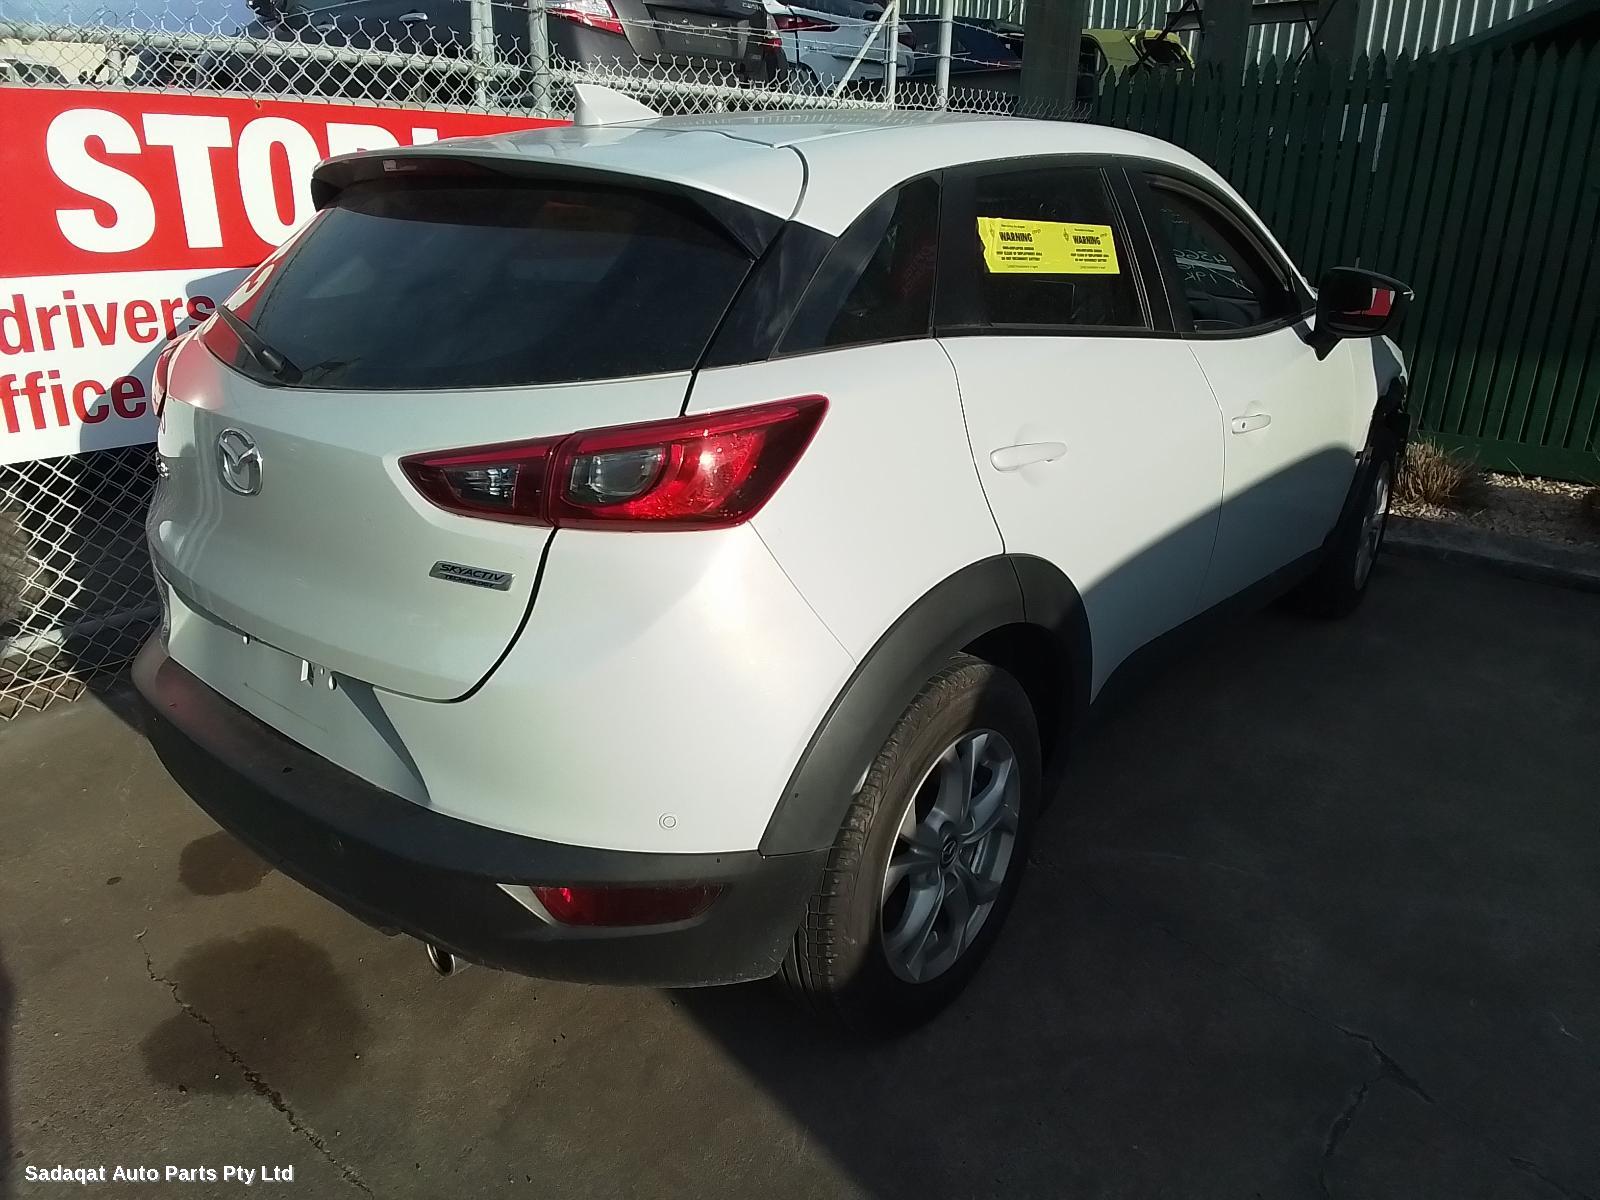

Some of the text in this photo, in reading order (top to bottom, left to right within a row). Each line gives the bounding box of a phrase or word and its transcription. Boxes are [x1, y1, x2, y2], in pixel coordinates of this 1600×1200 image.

[998, 232, 1033, 243] WARNING
[1072, 235, 1101, 245] WARNING
[0, 290, 216, 356] drivers
[440, 563, 505, 581] SKYACTIV
